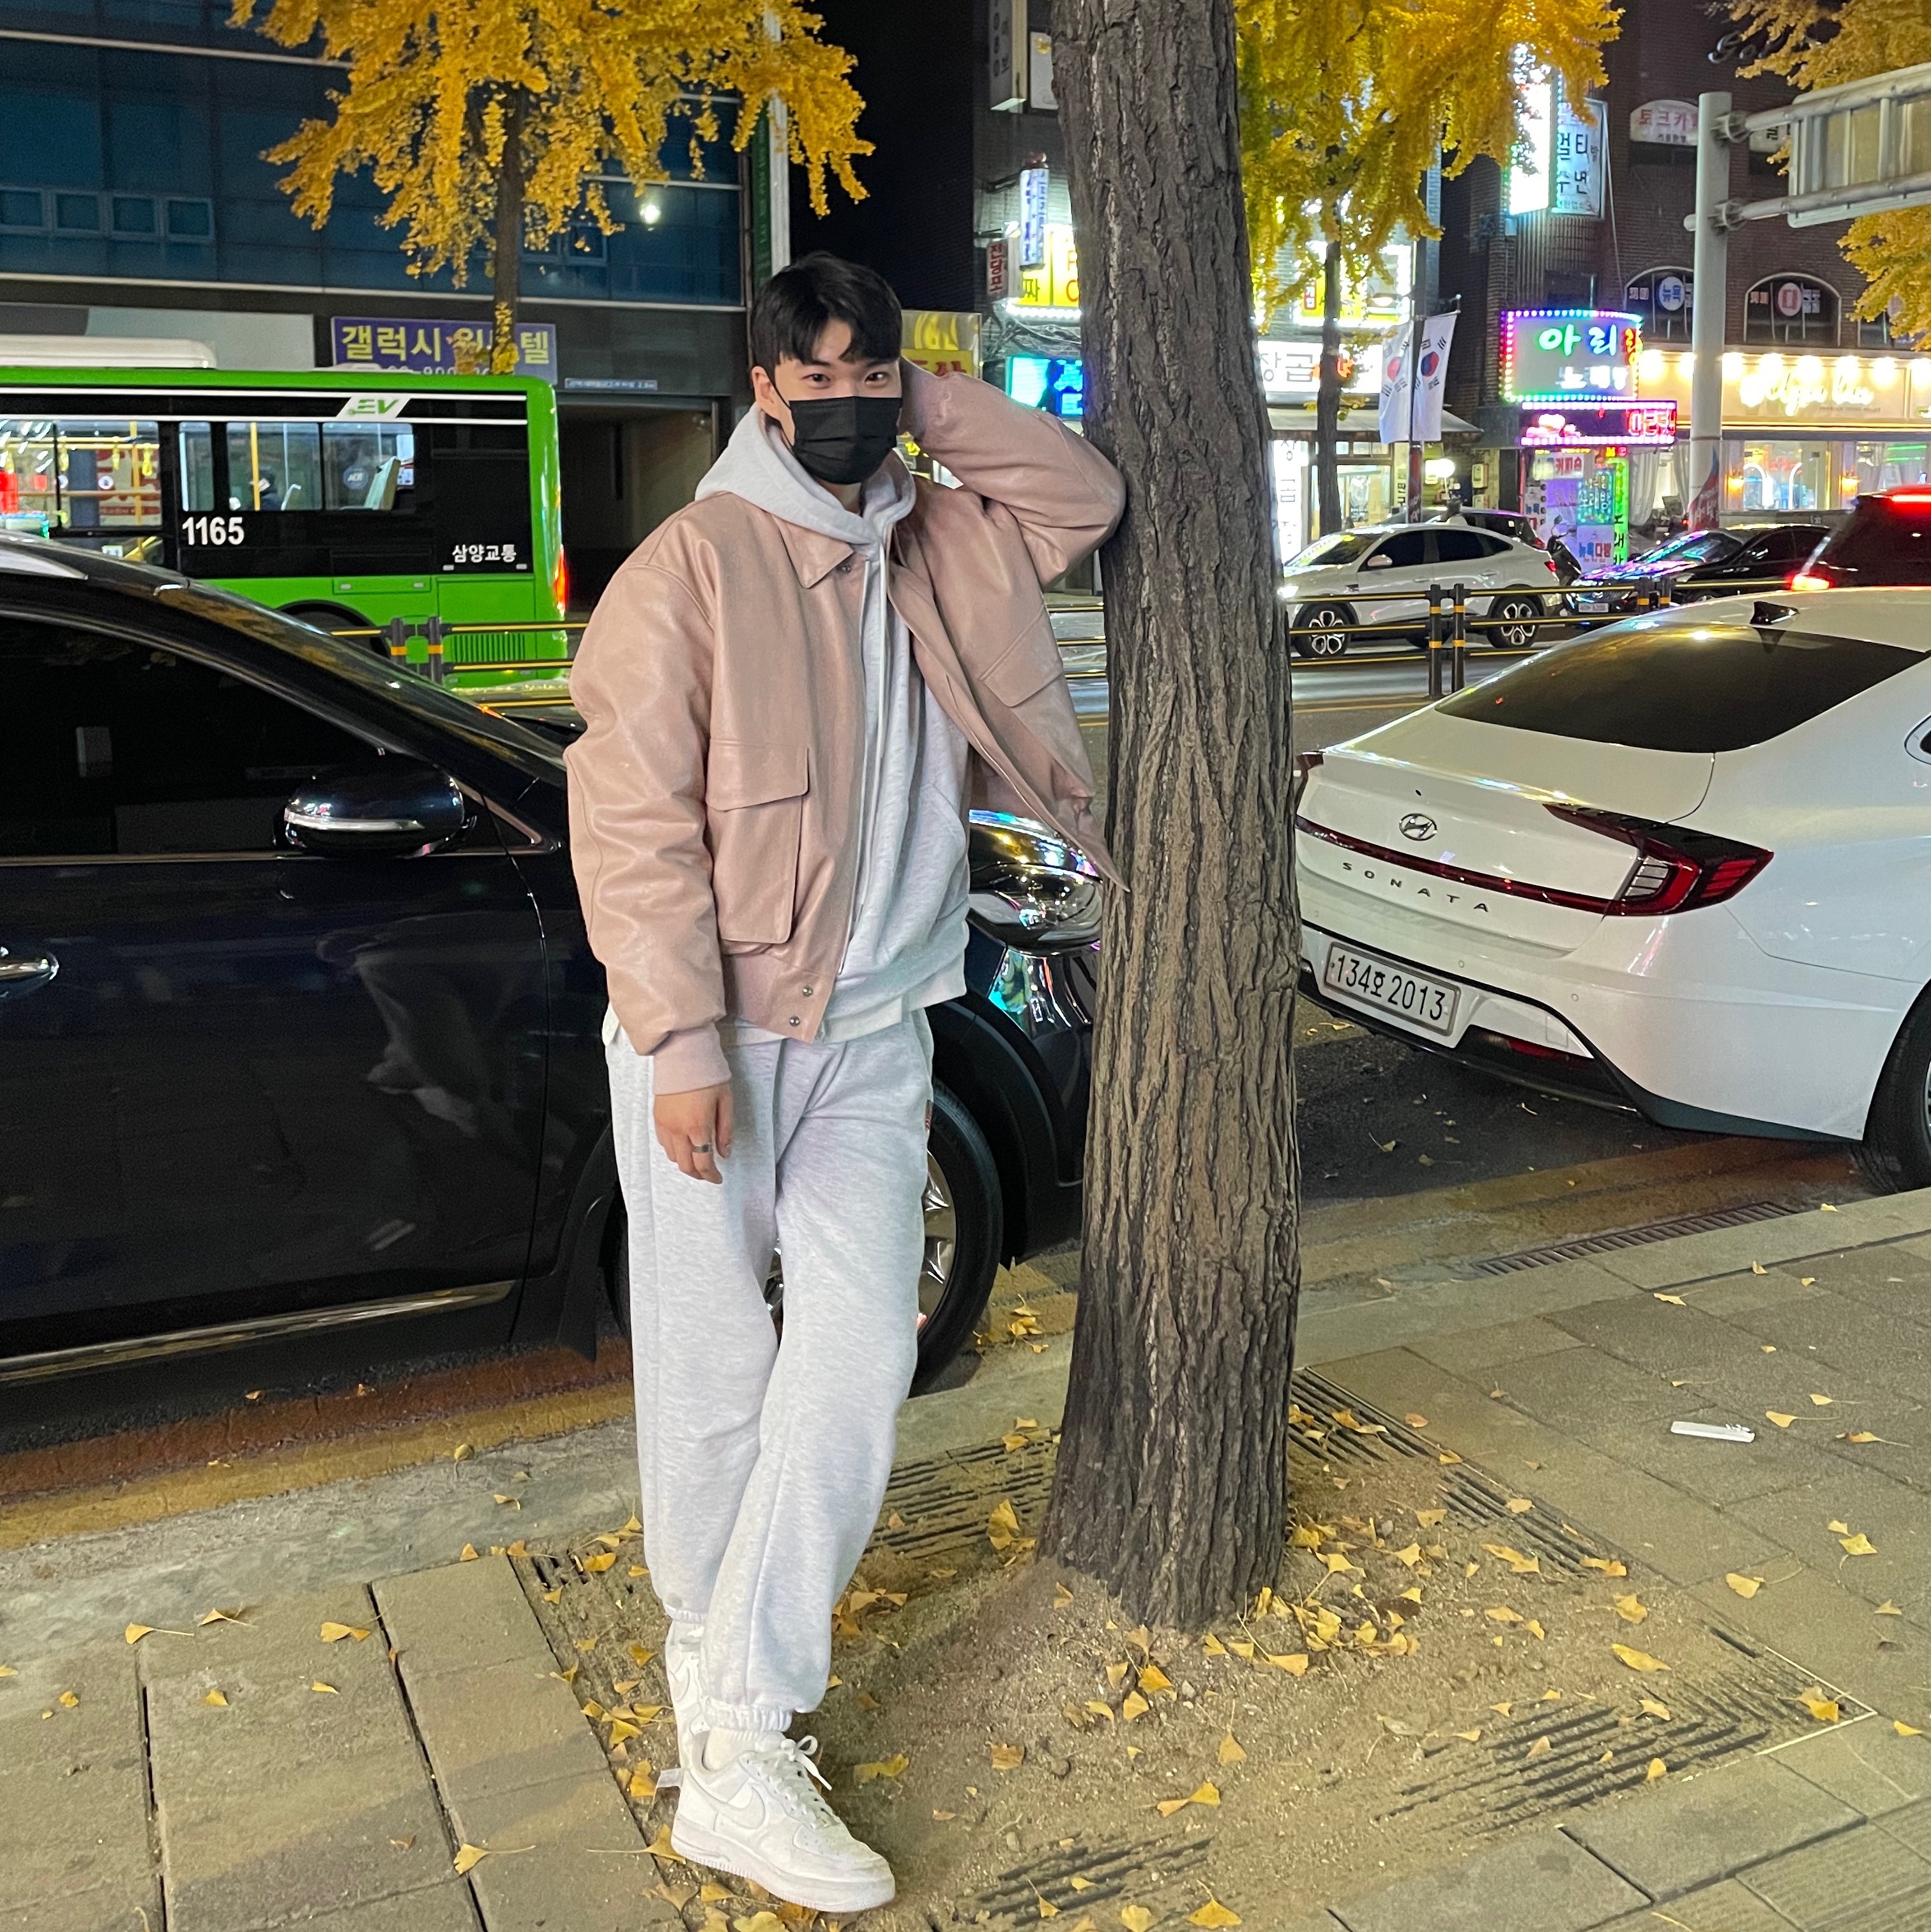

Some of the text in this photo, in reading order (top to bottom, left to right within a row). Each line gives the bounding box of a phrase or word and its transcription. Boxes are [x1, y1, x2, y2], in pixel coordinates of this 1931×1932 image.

[342, 324, 441, 362] 갤럭시
[182, 516, 245, 545] 1165
[452, 544, 517, 563] 삼양교통
[1342, 862, 1489, 913] SONATA
[1387, 975, 1446, 1021] 2013
